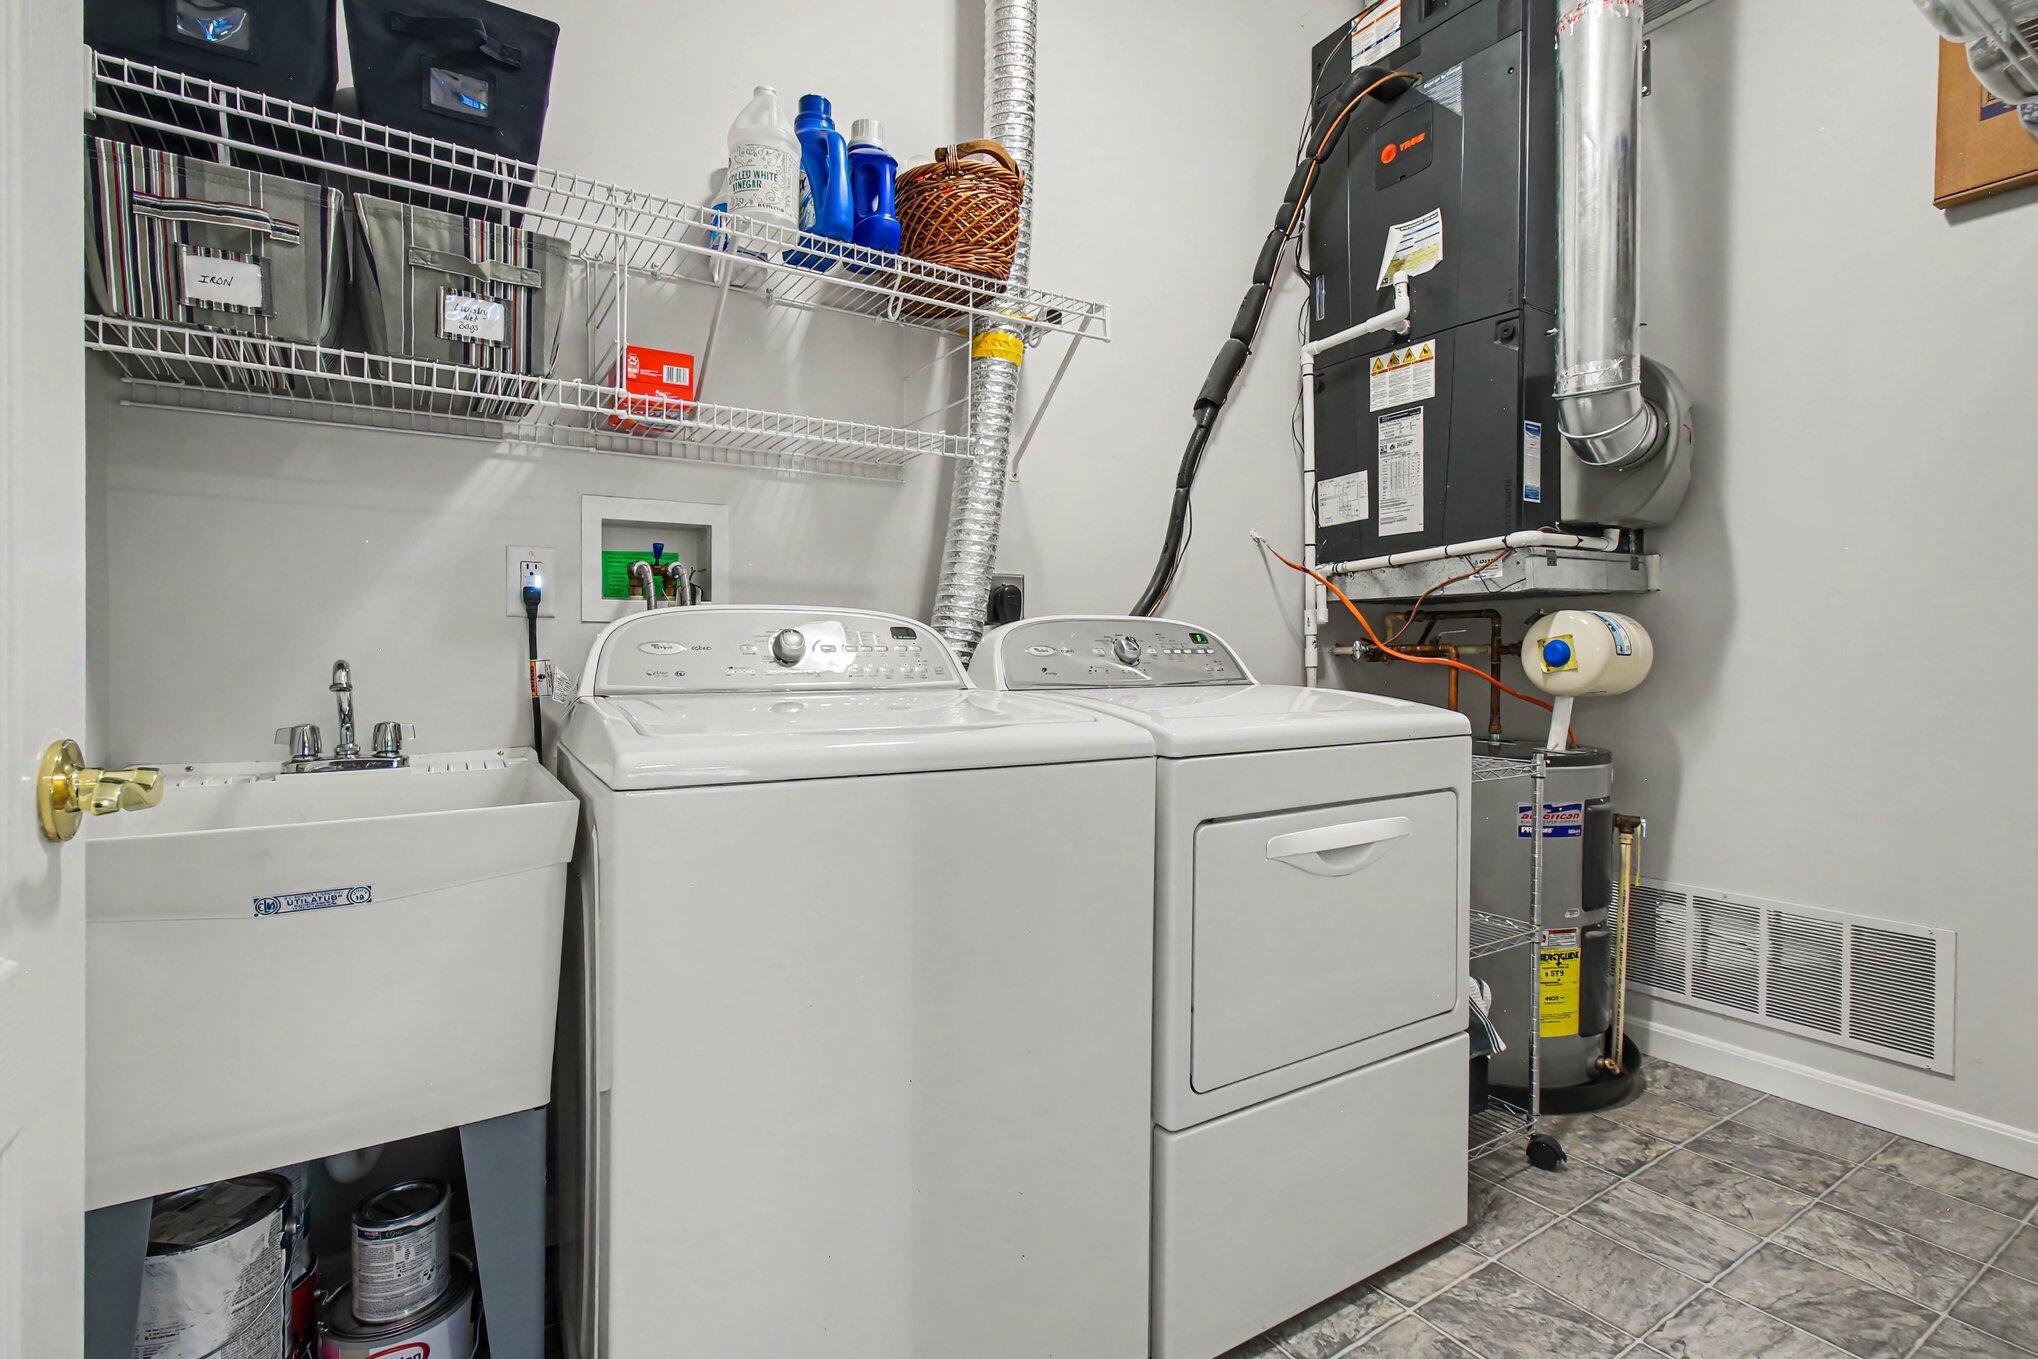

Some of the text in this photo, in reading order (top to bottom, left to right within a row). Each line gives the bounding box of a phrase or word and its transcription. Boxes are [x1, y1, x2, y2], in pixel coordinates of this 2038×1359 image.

[753, 170, 778, 183] WHITE
[732, 180, 762, 192] VINEGAR
[199, 275, 233, 287] IRON
